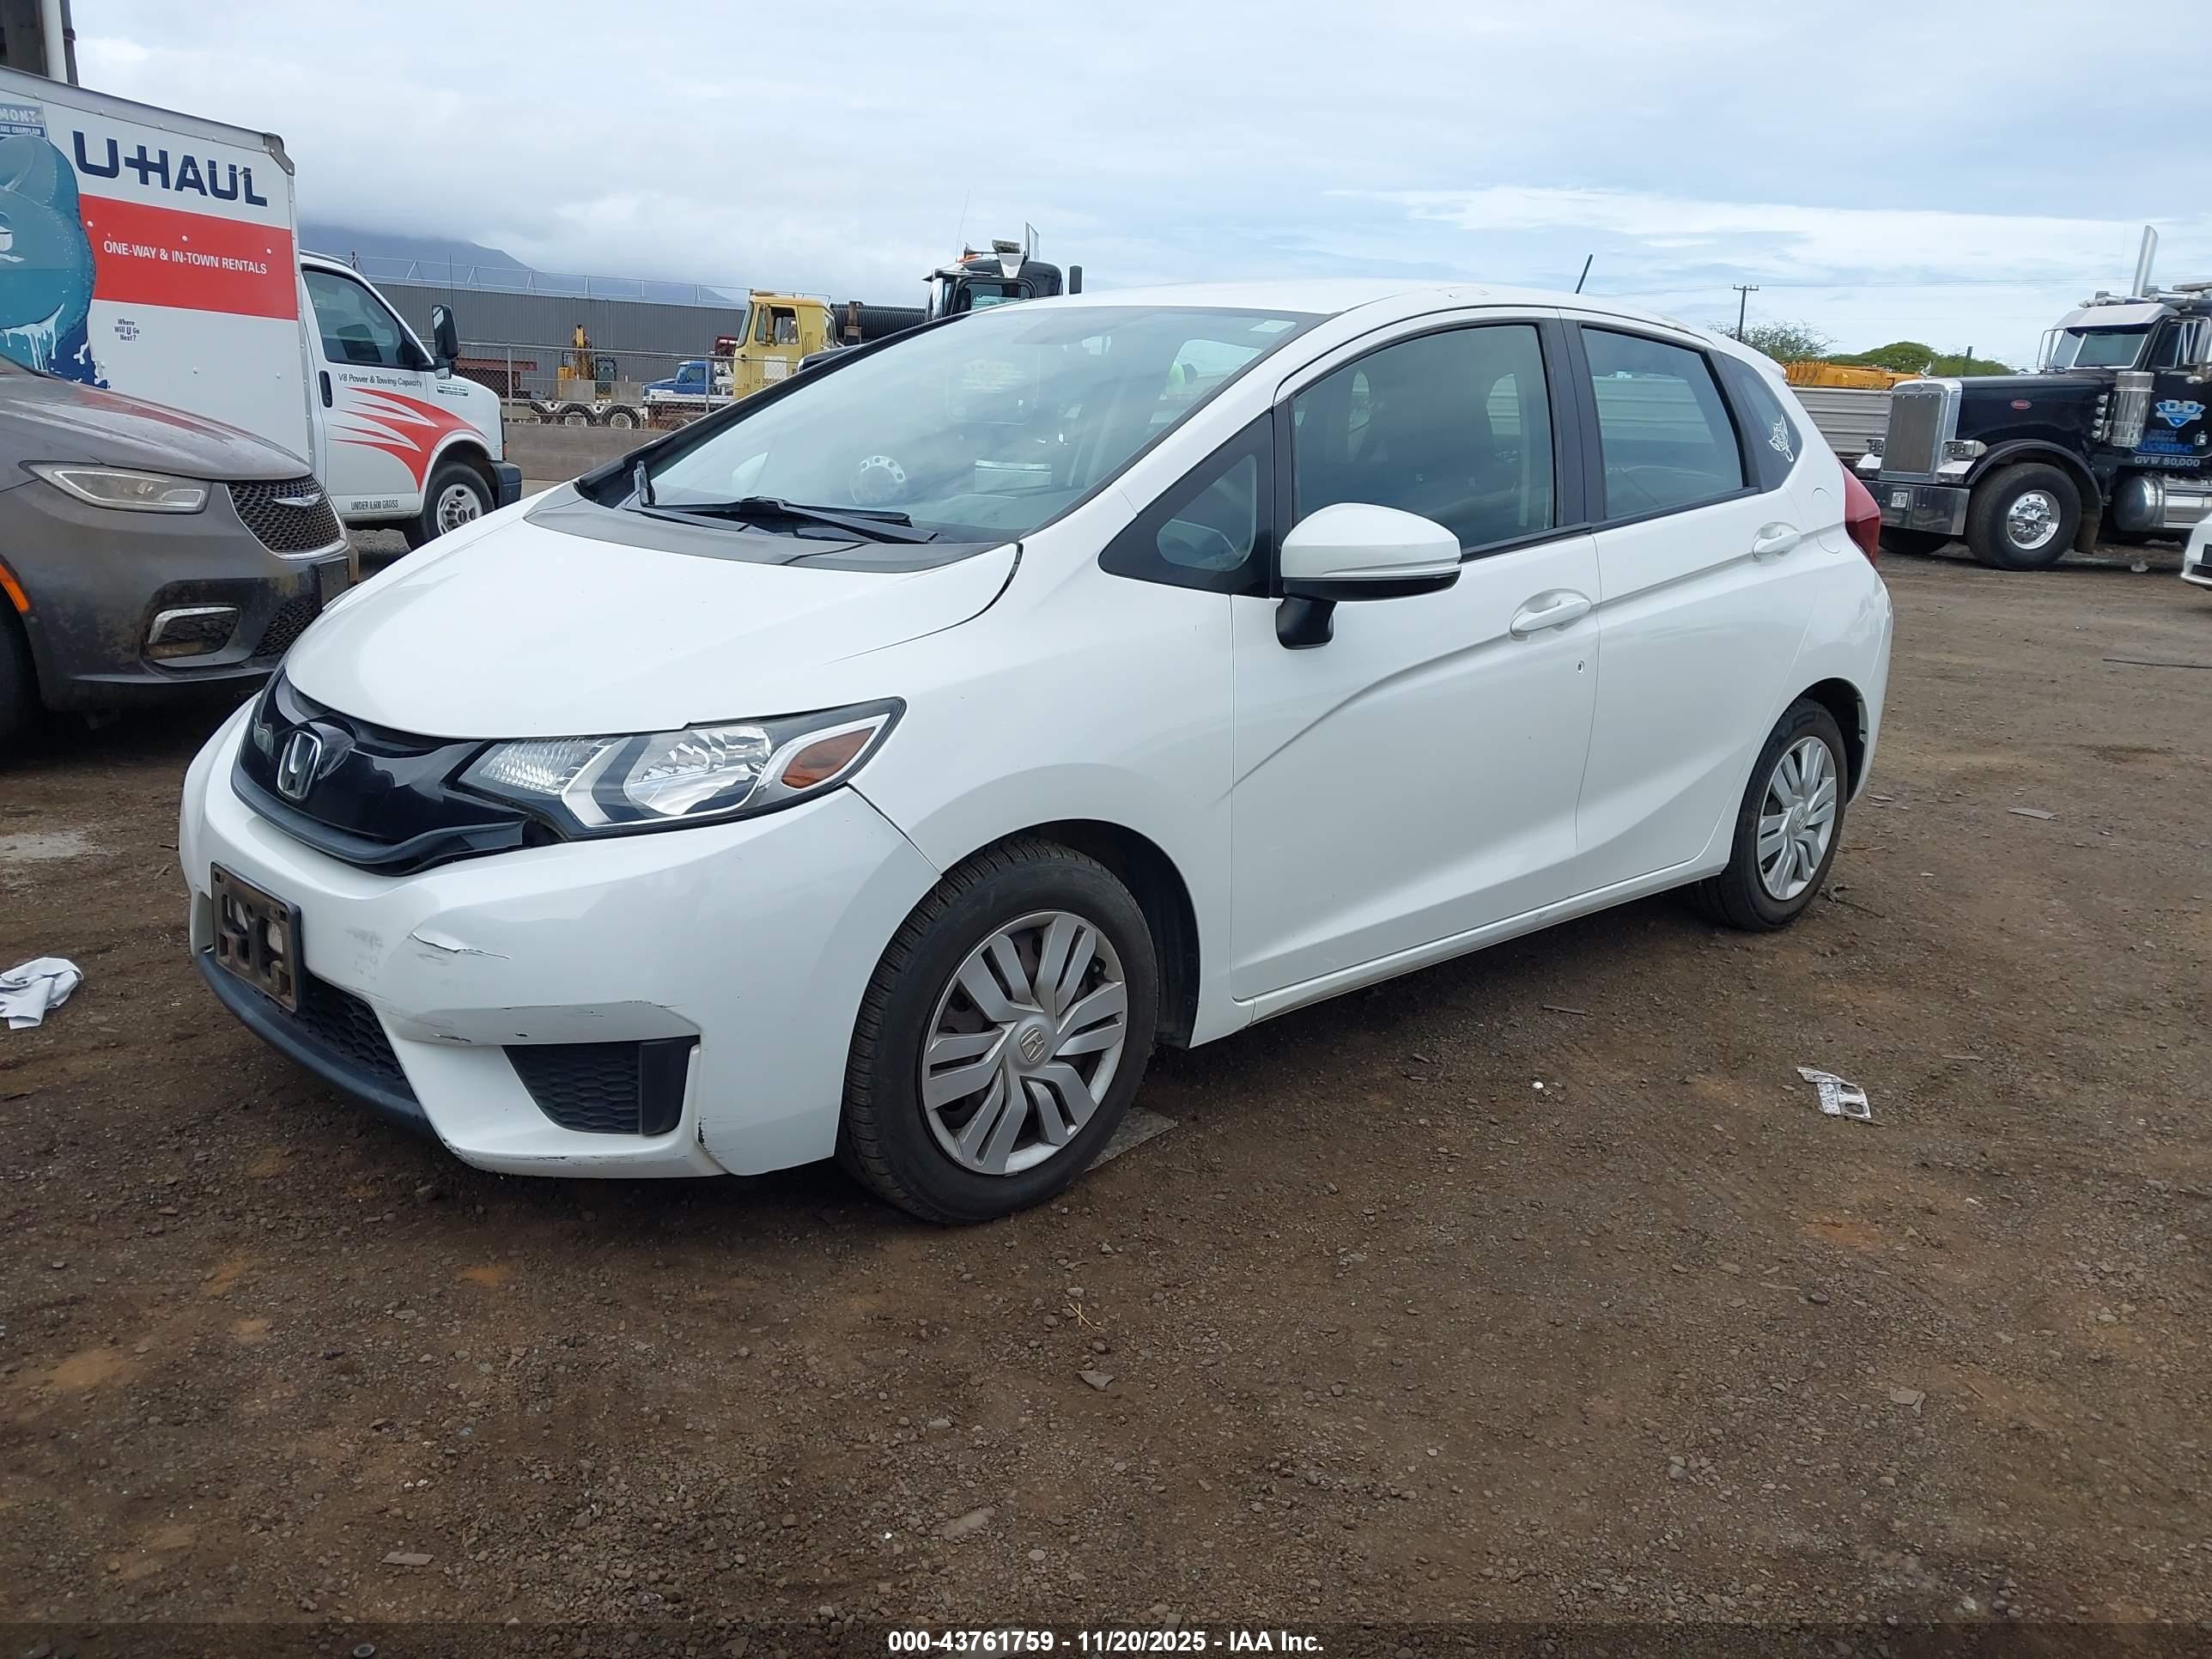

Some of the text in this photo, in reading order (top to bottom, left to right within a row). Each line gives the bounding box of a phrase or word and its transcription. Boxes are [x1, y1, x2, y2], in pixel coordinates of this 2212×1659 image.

[73, 131, 268, 207] U-HAUL
[103, 240, 267, 275] ONE-WAY & IN-TOWN RENTALS
[117, 318, 135, 326] Where
[126, 326, 131, 335] U
[337, 373, 348, 382] V8
[349, 374, 368, 384] Power
[376, 375, 397, 386] Towing
[397, 378, 422, 388] Capacity
[2135, 456, 2200, 467] GVW 80,000
[350, 499, 399, 511] UNDER 8,600 GROSS
